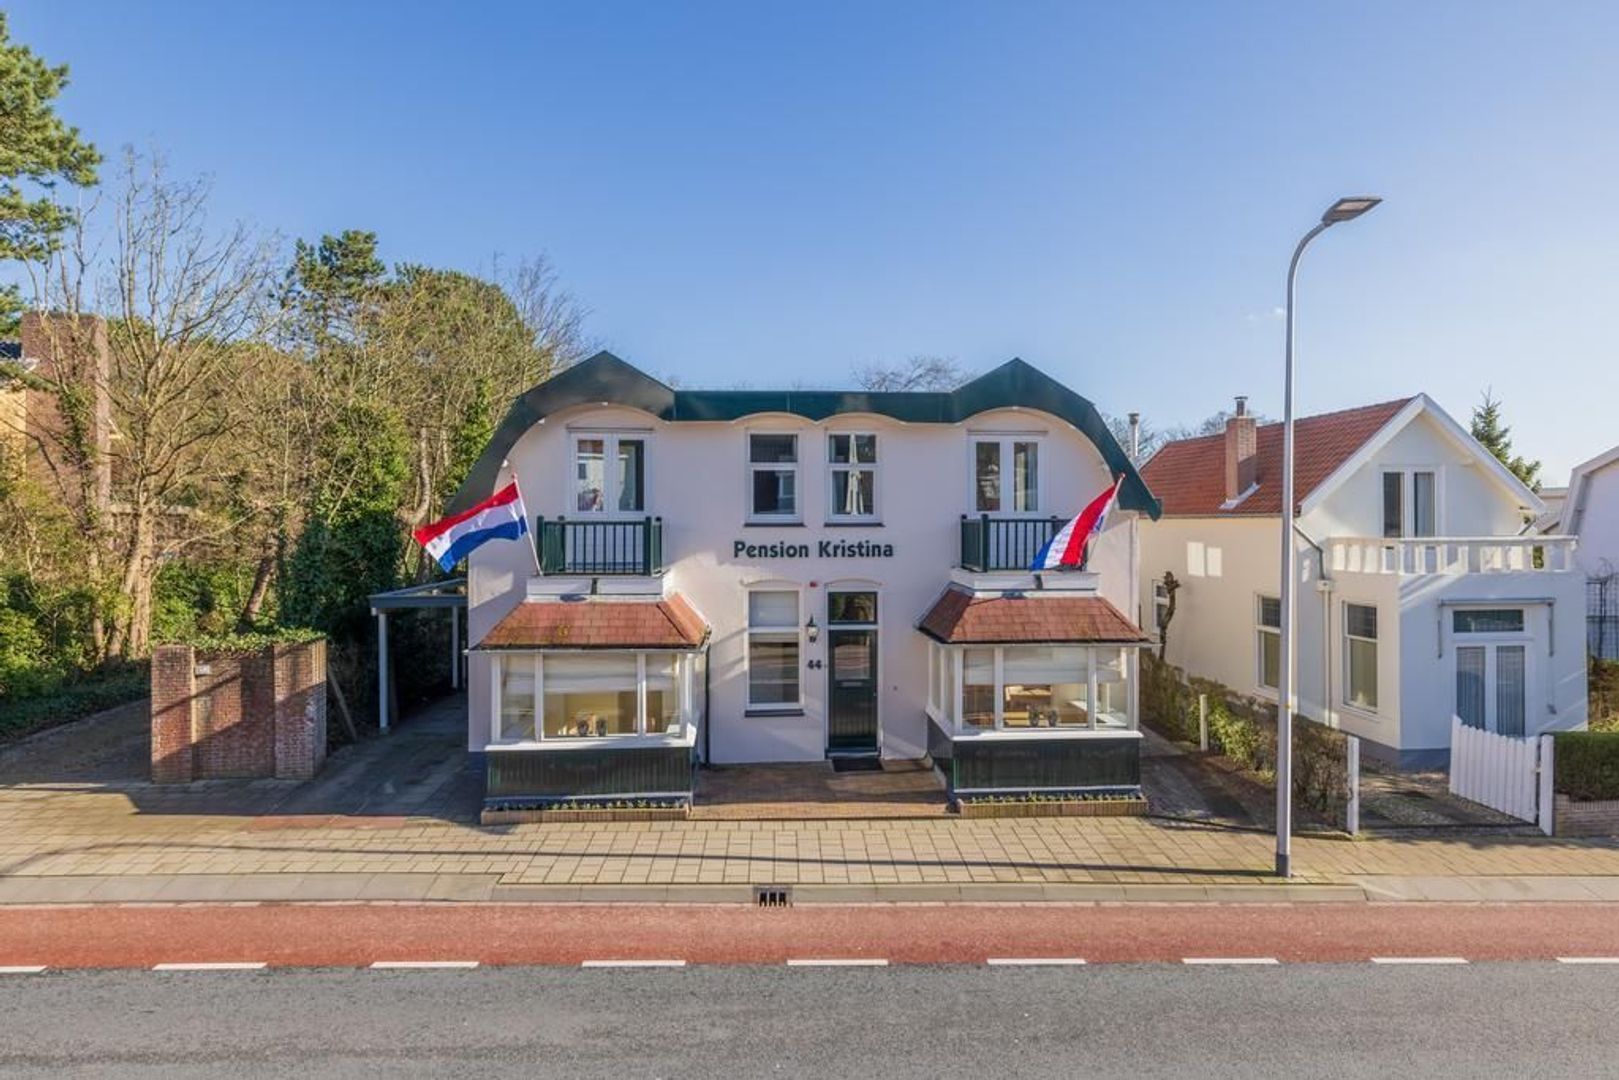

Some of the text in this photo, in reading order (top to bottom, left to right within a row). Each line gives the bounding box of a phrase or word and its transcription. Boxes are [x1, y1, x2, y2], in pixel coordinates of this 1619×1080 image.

[733, 539, 894, 558] Pension Kristina
[807, 659, 822, 670] 44
